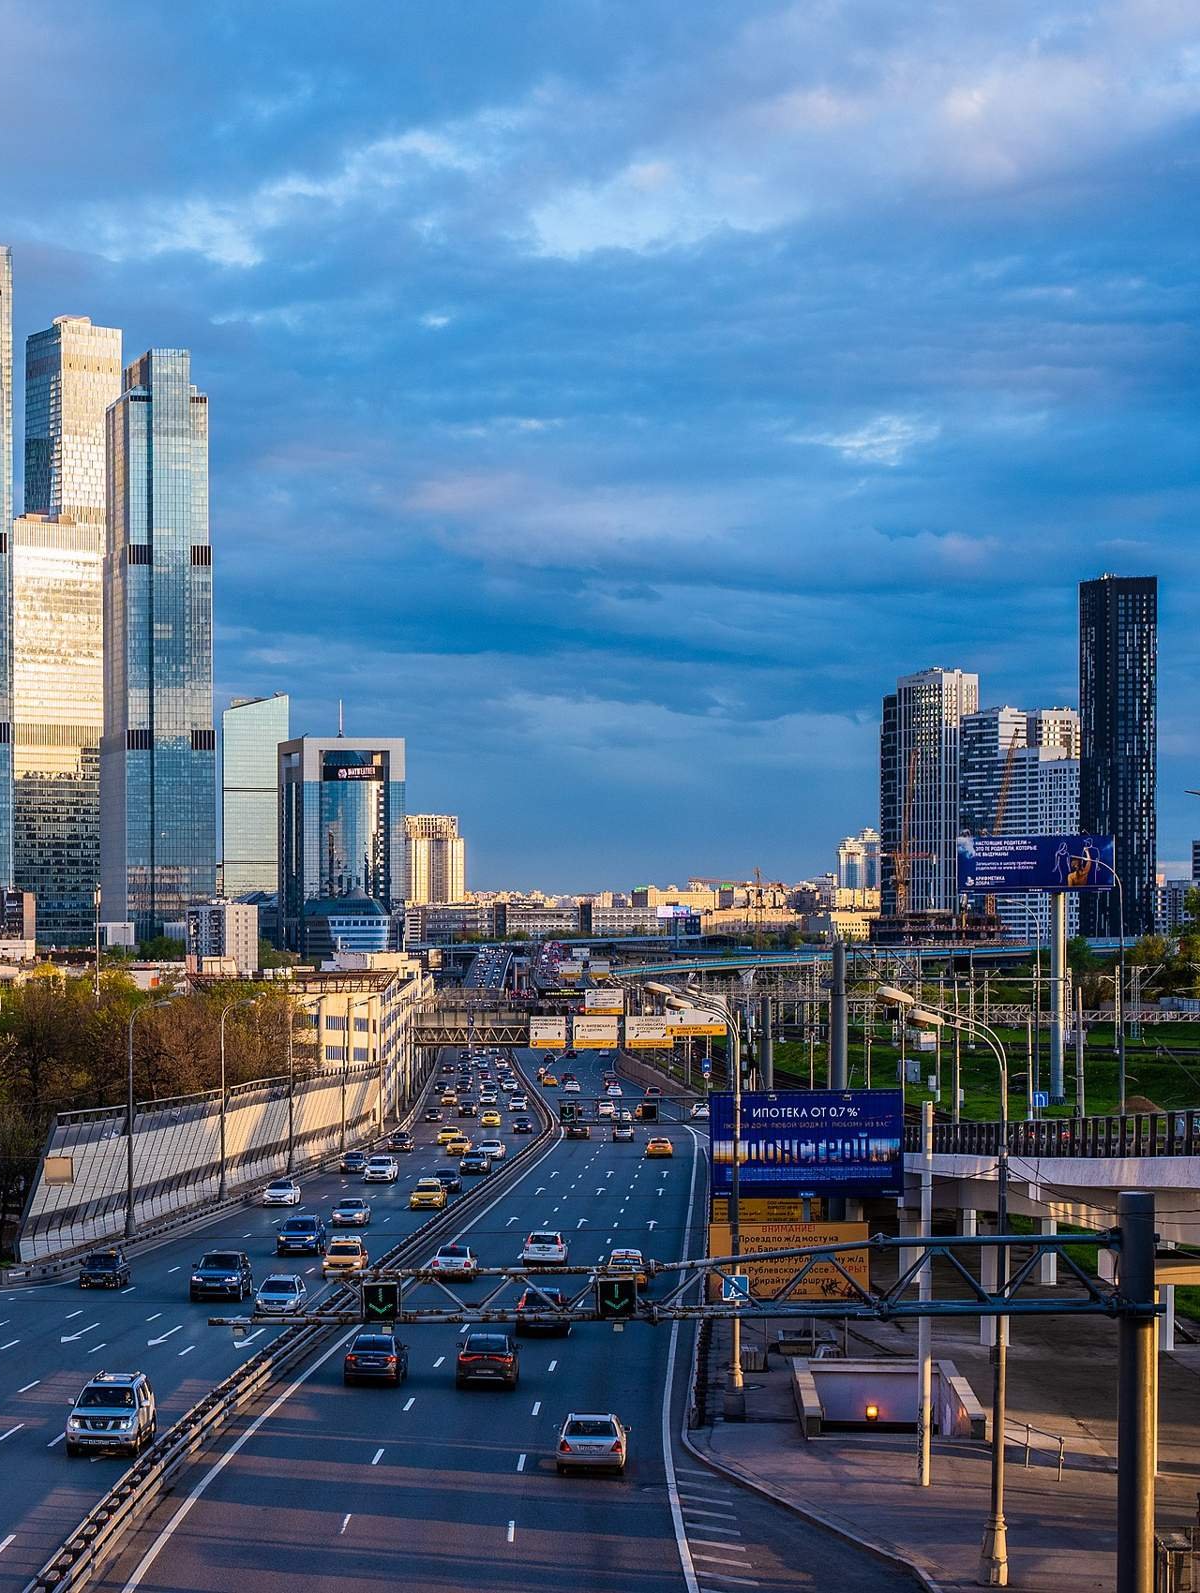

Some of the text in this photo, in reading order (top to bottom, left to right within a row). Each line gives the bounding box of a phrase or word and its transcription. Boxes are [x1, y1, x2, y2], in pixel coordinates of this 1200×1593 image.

[752, 1107, 808, 1118] ИПОТЕКА
[810, 1107, 826, 1117] ОТ
[771, 1287, 807, 1295] обзда
